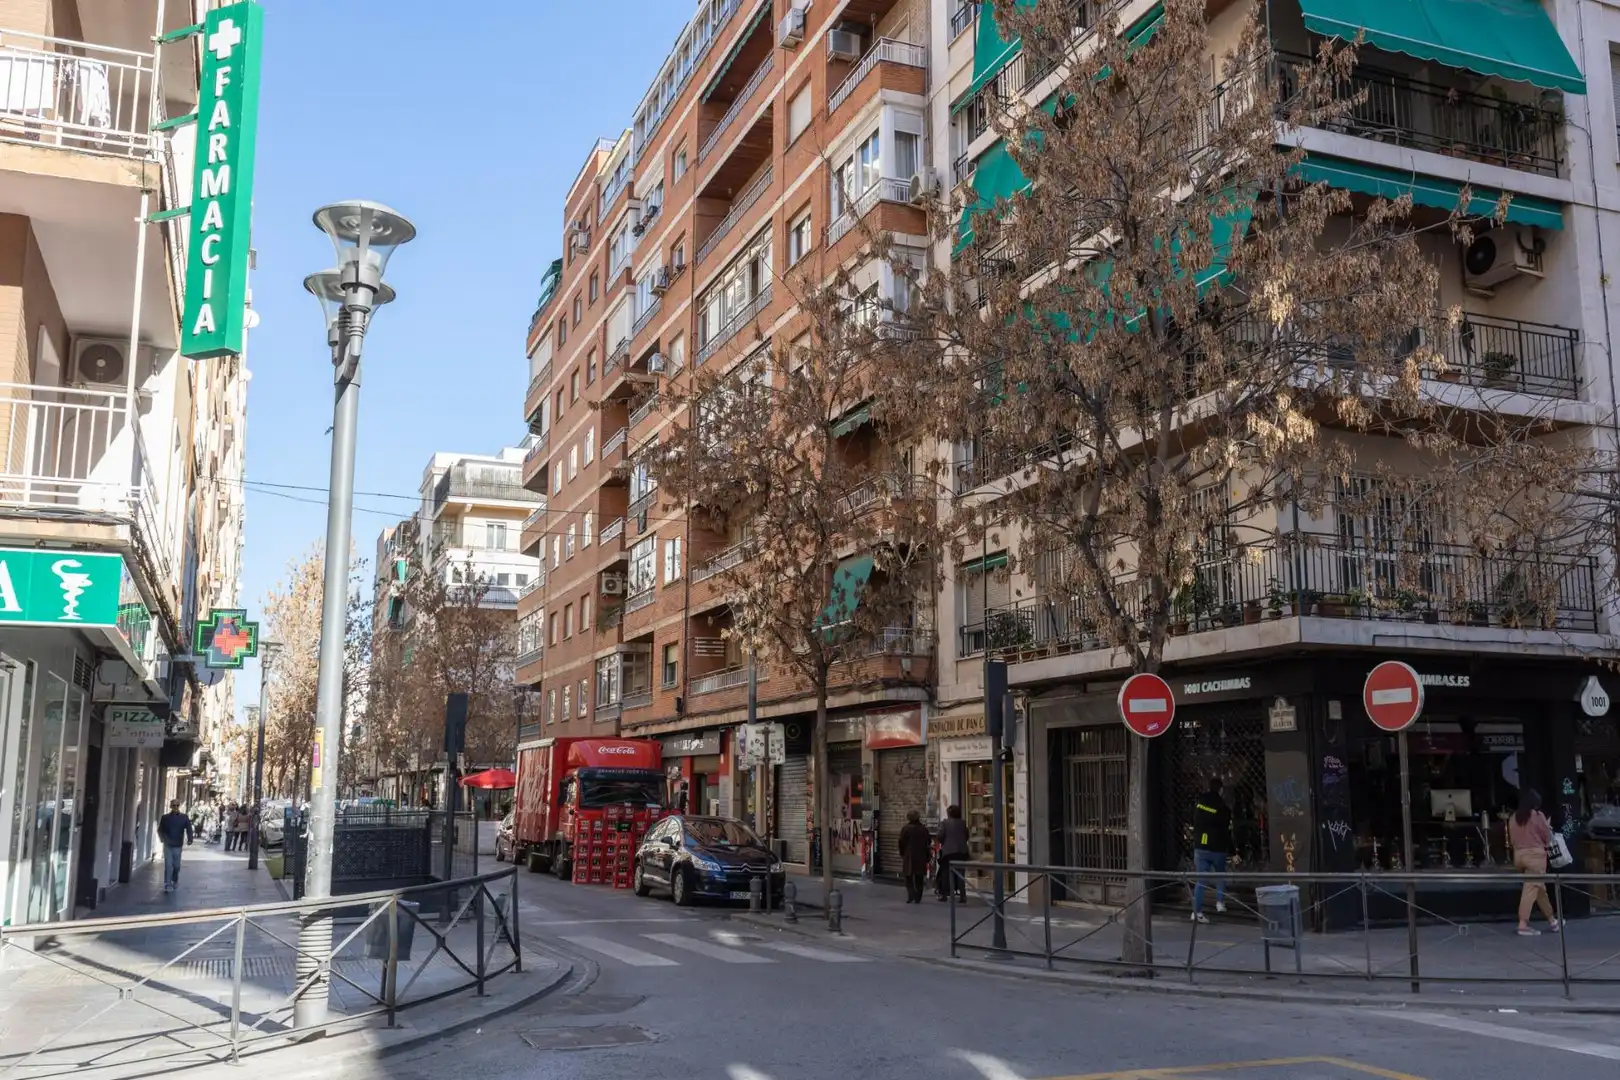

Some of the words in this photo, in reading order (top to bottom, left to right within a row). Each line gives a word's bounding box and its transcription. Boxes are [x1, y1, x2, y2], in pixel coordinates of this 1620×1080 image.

[193, 66, 232, 336] FARMACIA
[0, 559, 23, 612] A
[1201, 677, 1251, 692] CACHIMBAS
[1591, 697, 1606, 707] 1001
[112, 711, 162, 722] PIZZA
[957, 718, 964, 730] DE
[966, 716, 978, 730] PAN
[598, 745, 636, 754] Coca-Cola
